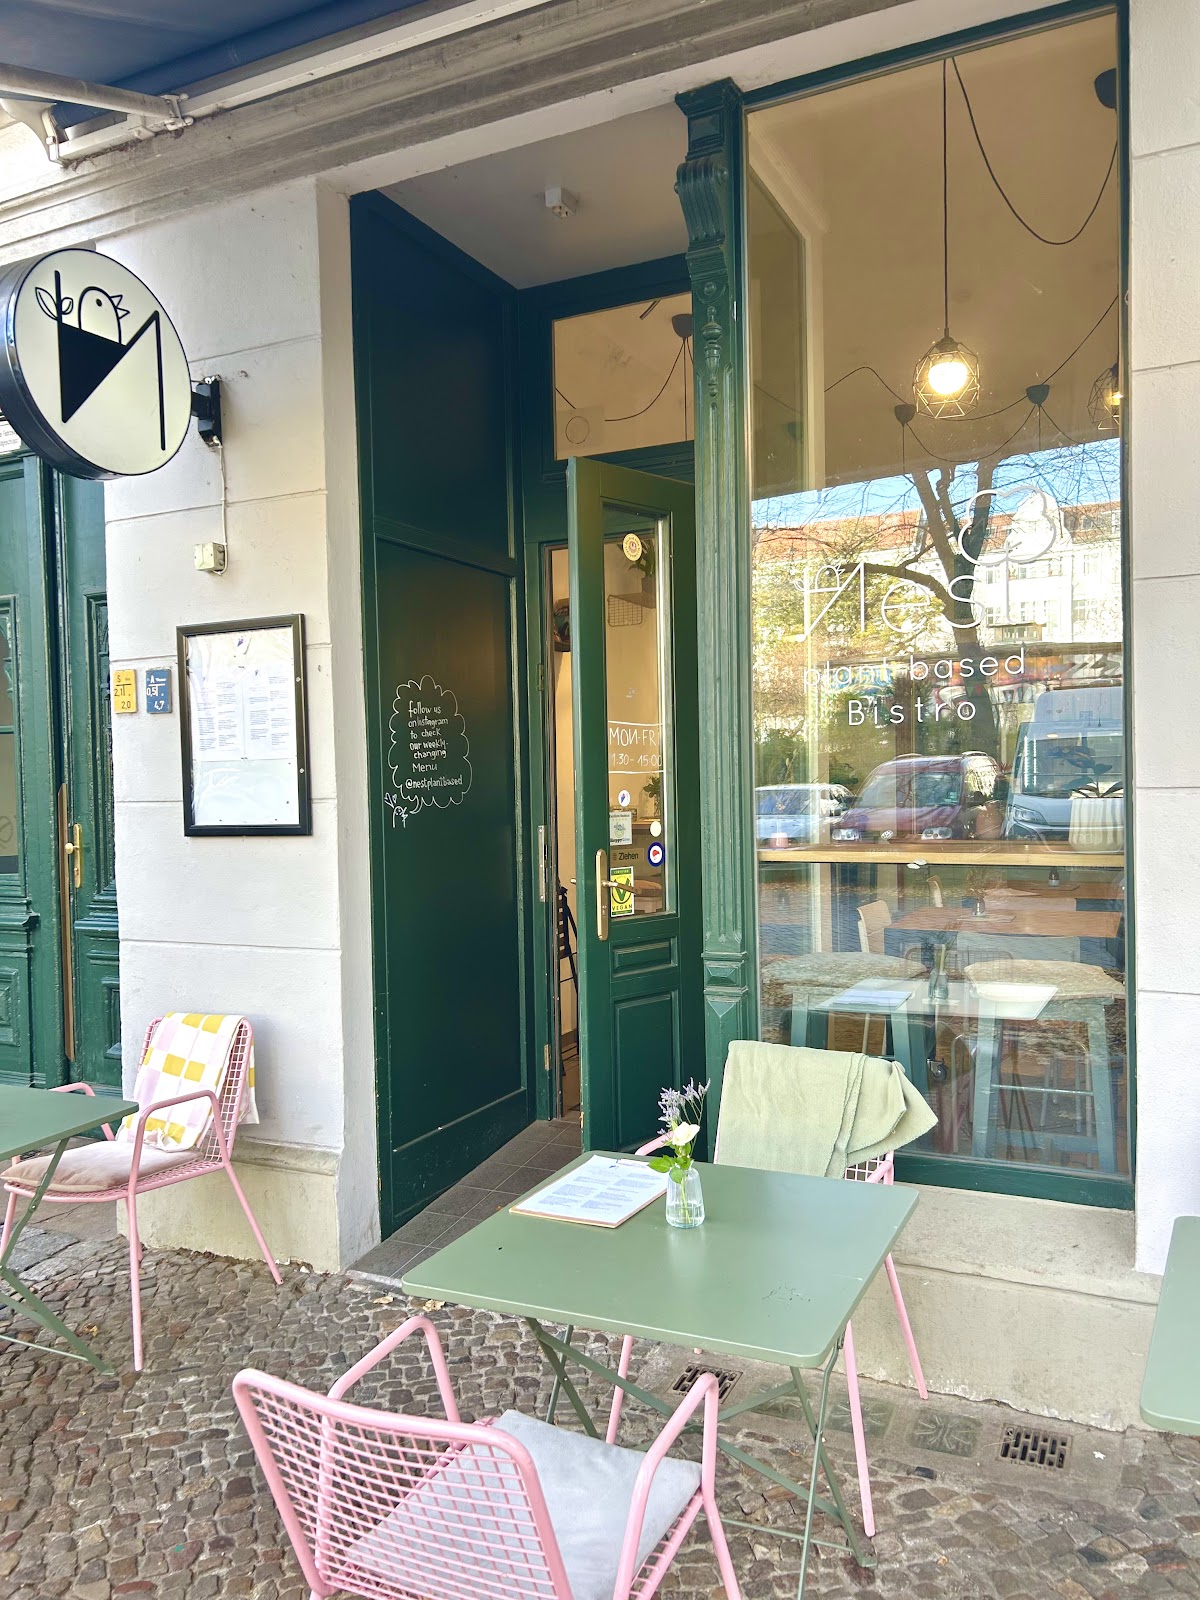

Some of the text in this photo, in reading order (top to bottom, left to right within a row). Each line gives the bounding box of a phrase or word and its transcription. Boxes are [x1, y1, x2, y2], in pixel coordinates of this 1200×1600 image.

[803, 646, 1025, 693] plant based
[433, 706, 442, 714] us
[847, 696, 976, 726] Bistro
[410, 728, 442, 740] to check
[413, 749, 447, 760] changing
[412, 763, 438, 773] Menu
[405, 775, 463, 790] @nestplantbased
[618, 851, 639, 861] Ziehen
[612, 903, 633, 911] VEGAN
